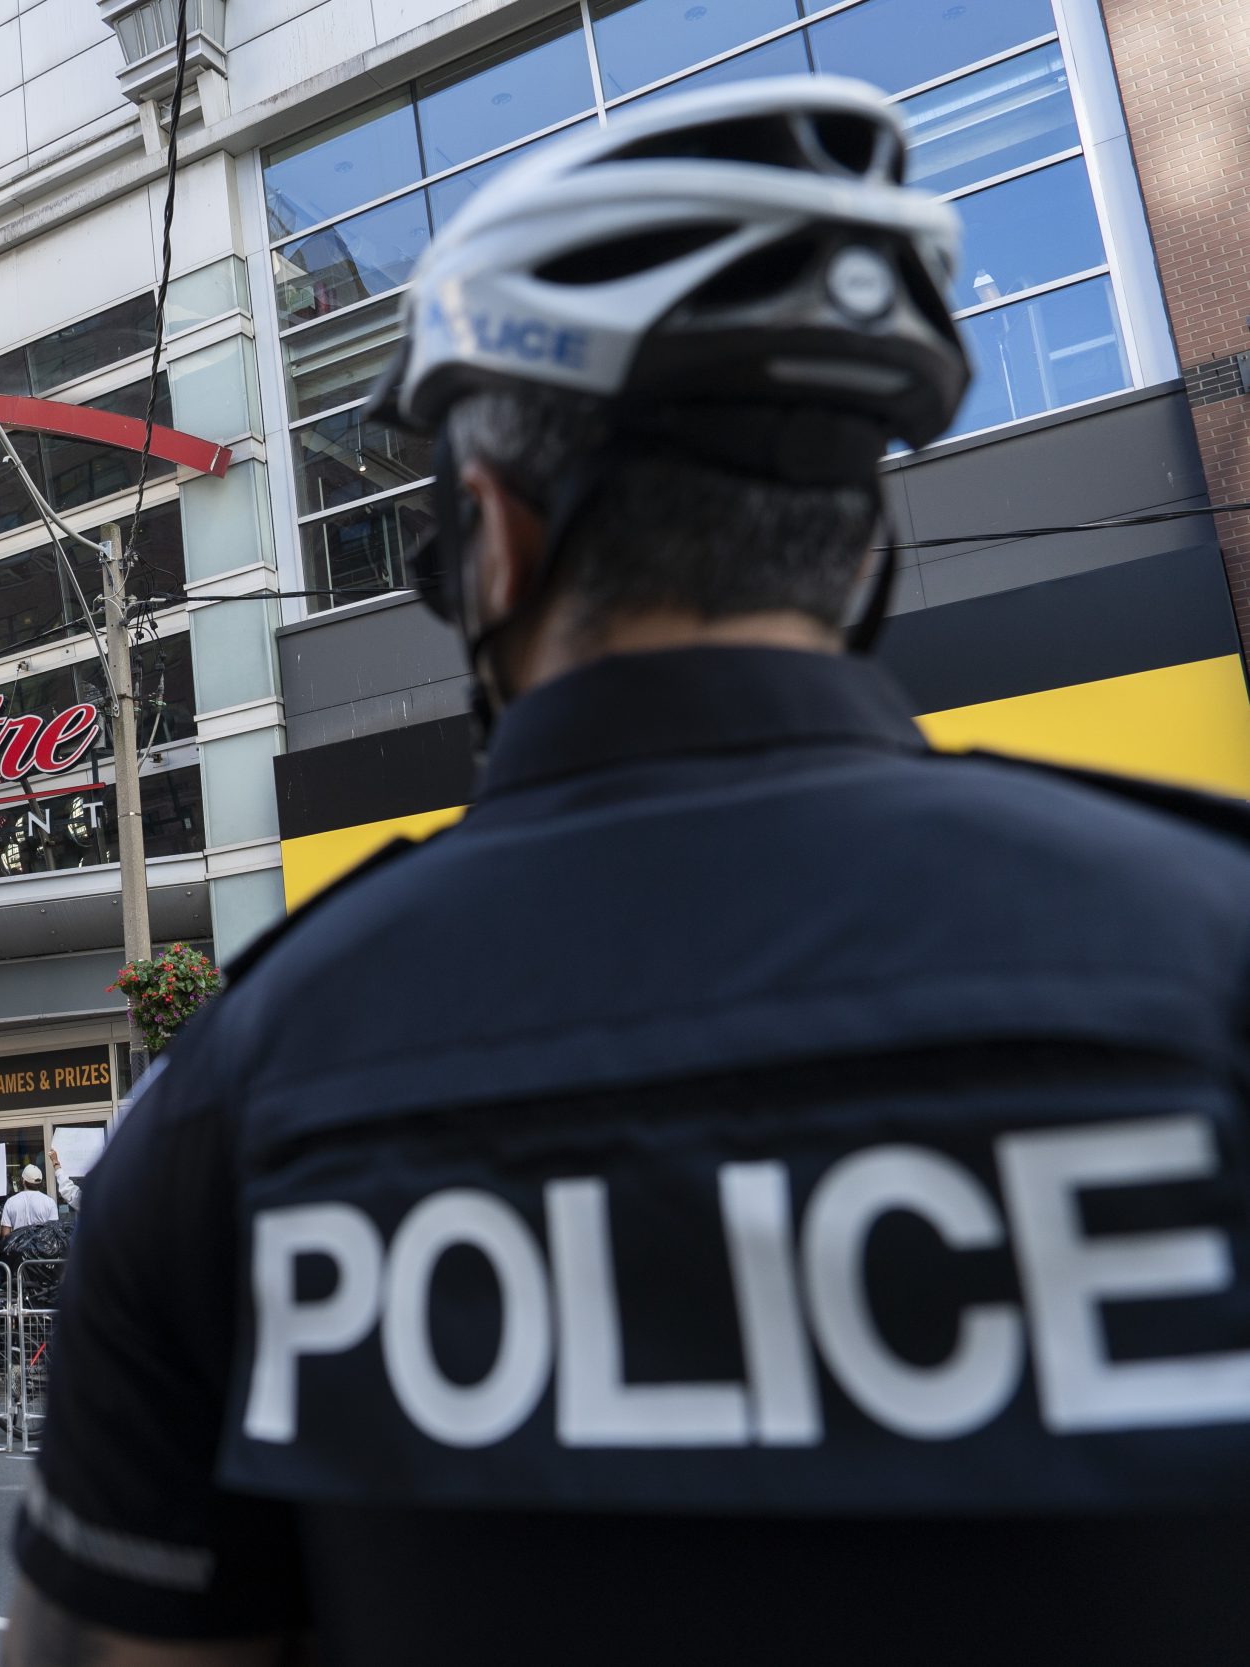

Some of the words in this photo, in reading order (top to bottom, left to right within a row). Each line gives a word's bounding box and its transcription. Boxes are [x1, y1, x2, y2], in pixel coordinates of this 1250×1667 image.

[39, 1070, 50, 1090] &
[55, 1063, 110, 1089] PRIZES
[243, 1114, 1250, 1449] POLICE
